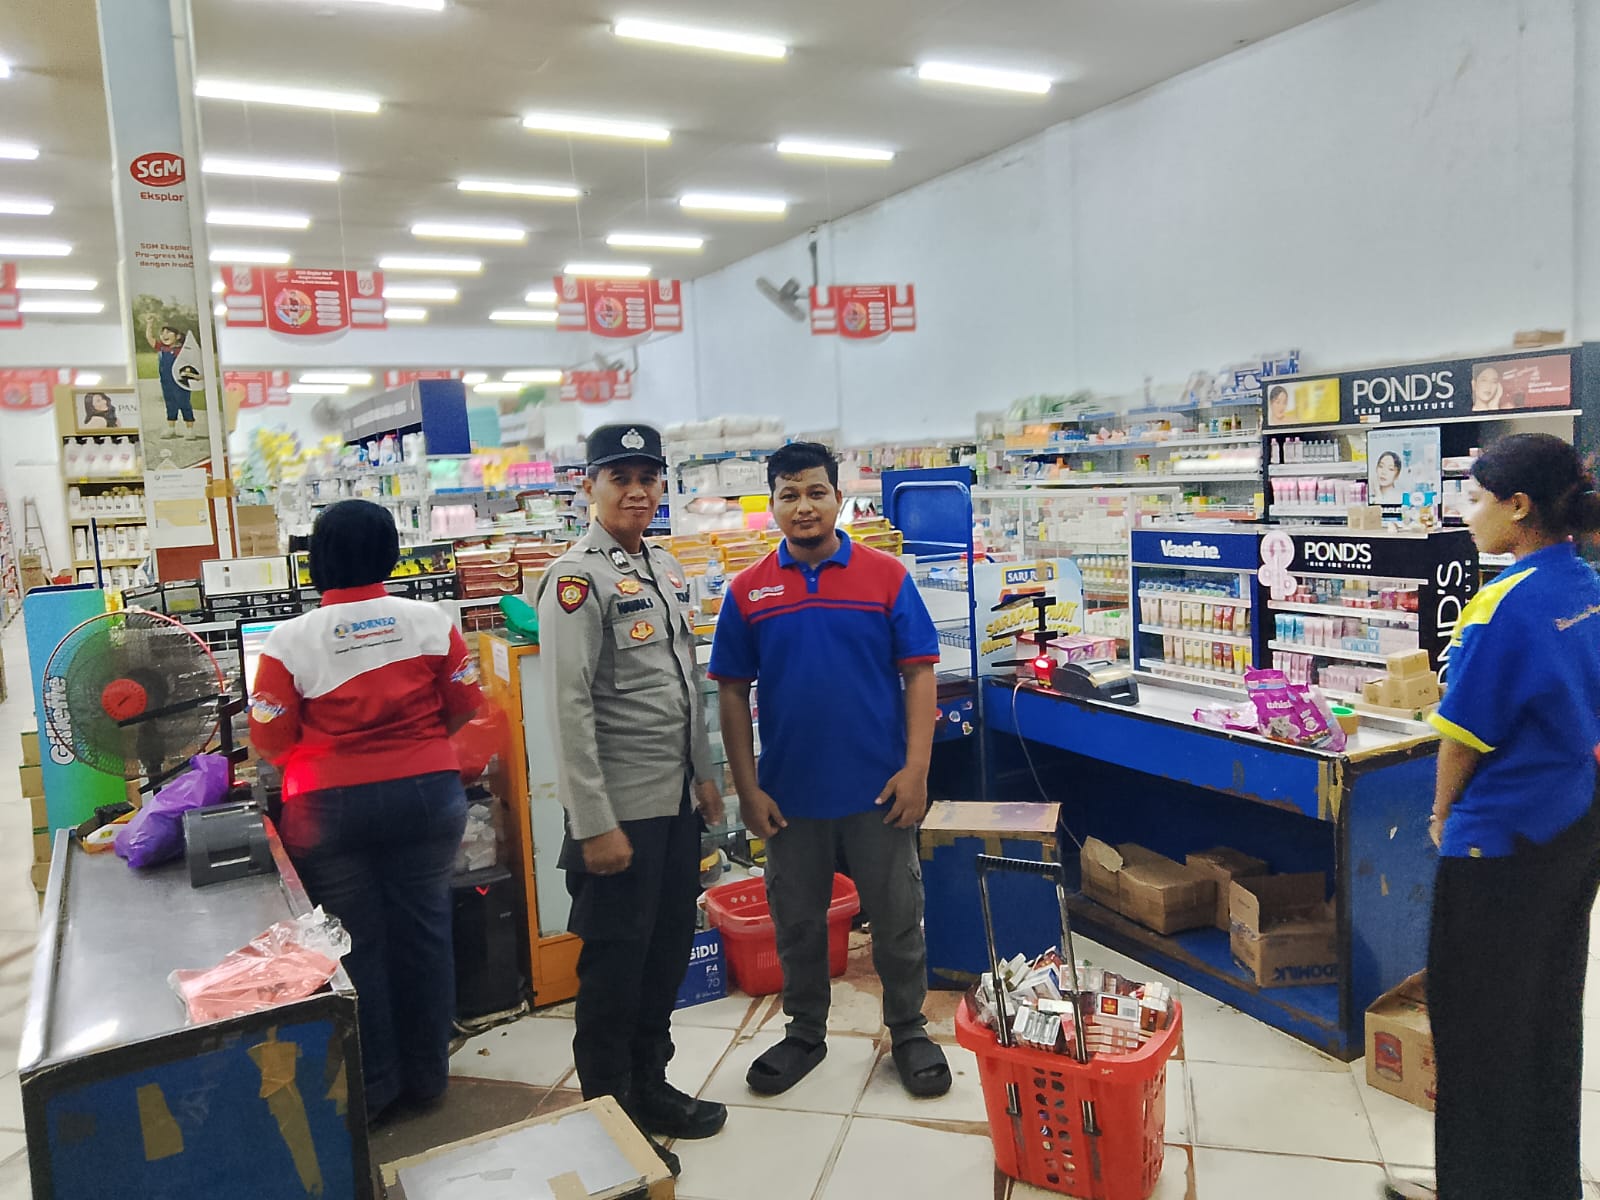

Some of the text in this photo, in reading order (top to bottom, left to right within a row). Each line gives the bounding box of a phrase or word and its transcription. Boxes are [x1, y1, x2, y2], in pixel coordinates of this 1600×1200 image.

[136, 160, 182, 178] SGM
[140, 192, 184, 202] Eksplor
[1353, 370, 1454, 406] POND'S
[1387, 401, 1454, 413] INSTITUTE
[1304, 541, 1372, 563] POND'S
[1007, 566, 1053, 582] SARI RI
[351, 616, 397, 633] BORNEO
[706, 963, 718, 974] F4
